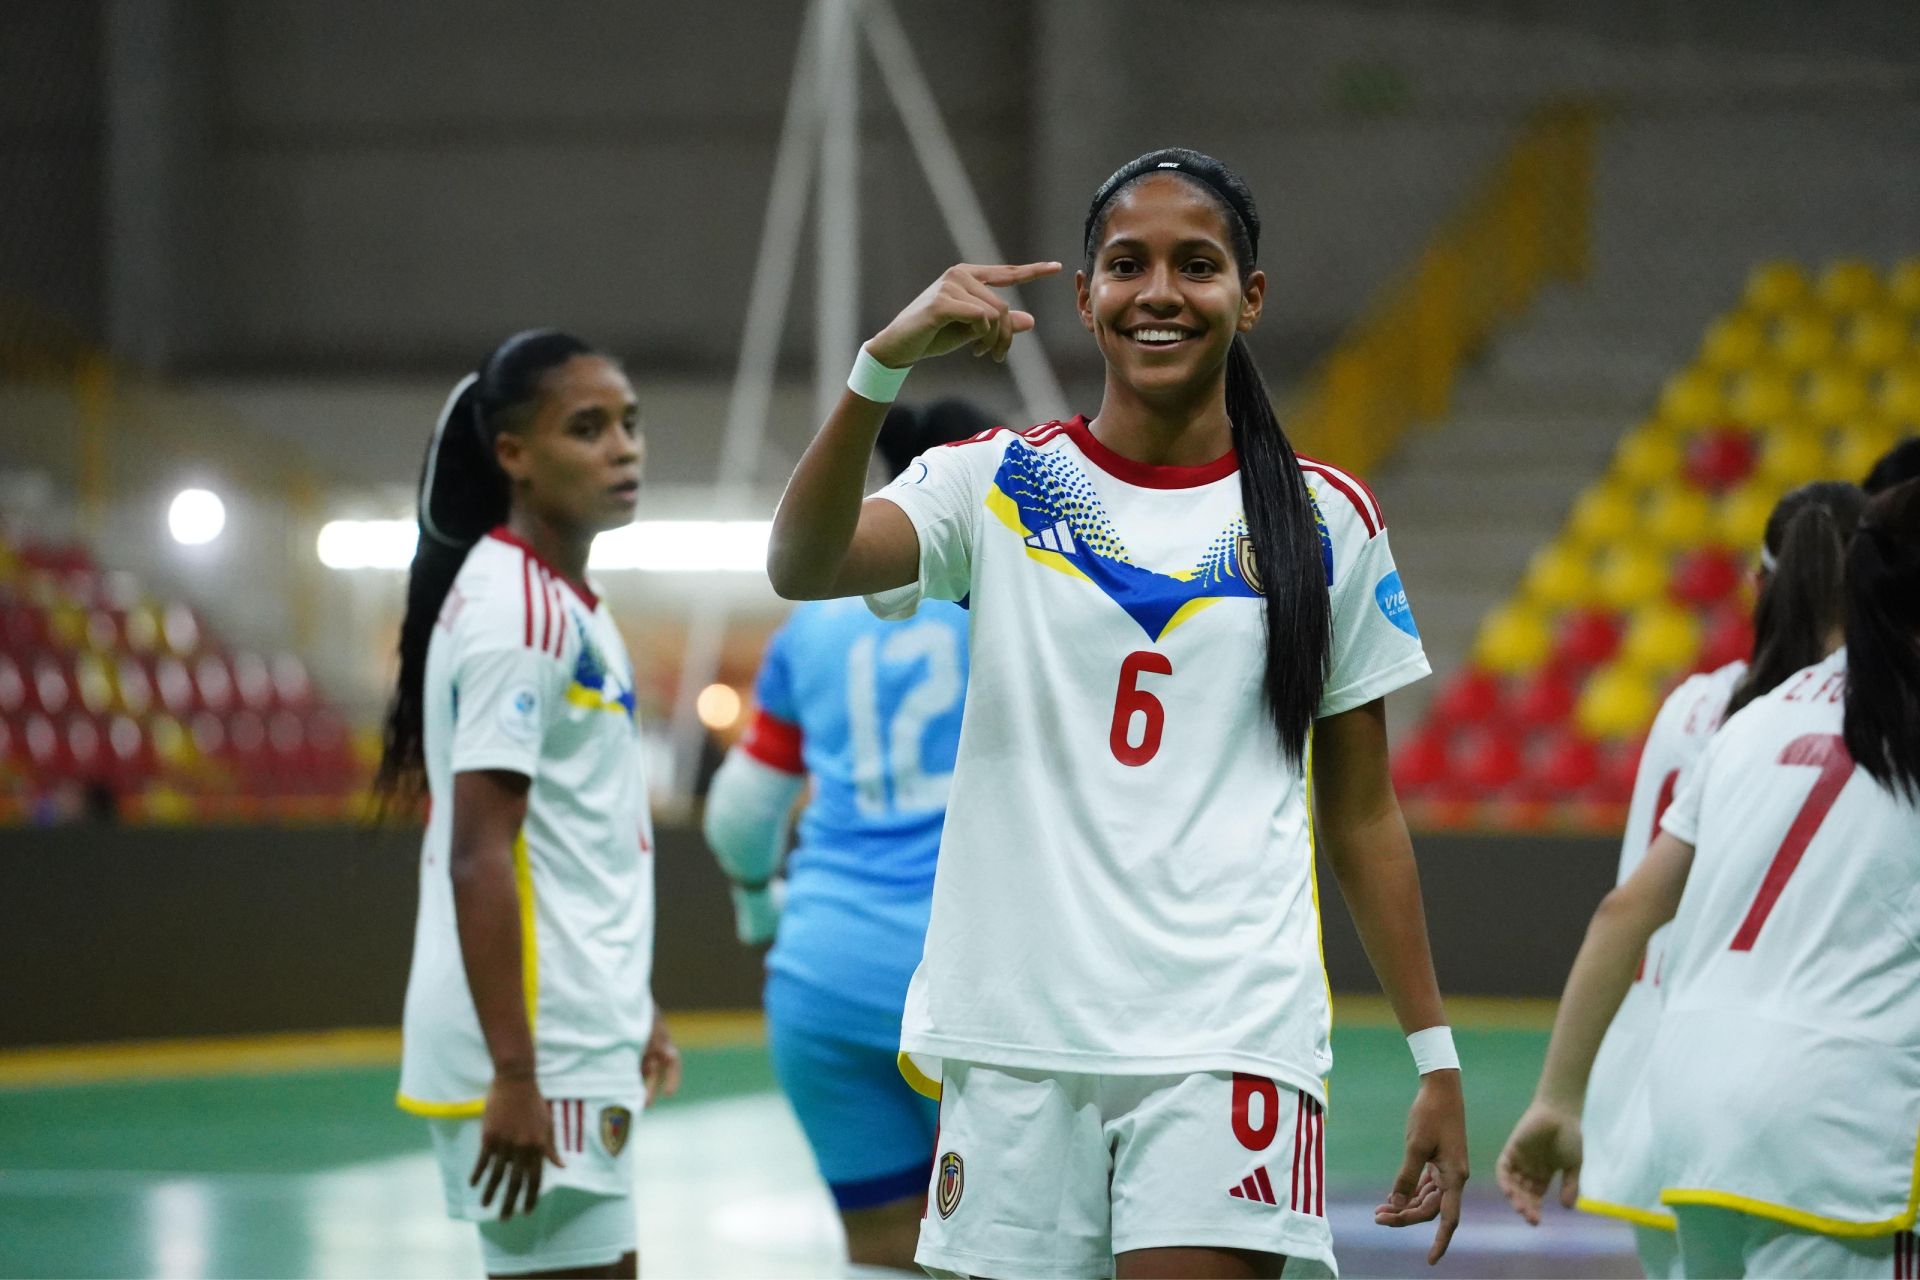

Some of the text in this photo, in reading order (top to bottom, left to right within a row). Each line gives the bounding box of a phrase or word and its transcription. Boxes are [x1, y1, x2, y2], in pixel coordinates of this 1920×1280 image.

[848, 622, 963, 824] 12
[1109, 650, 1173, 767] 6
[1728, 732, 1857, 952] 7
